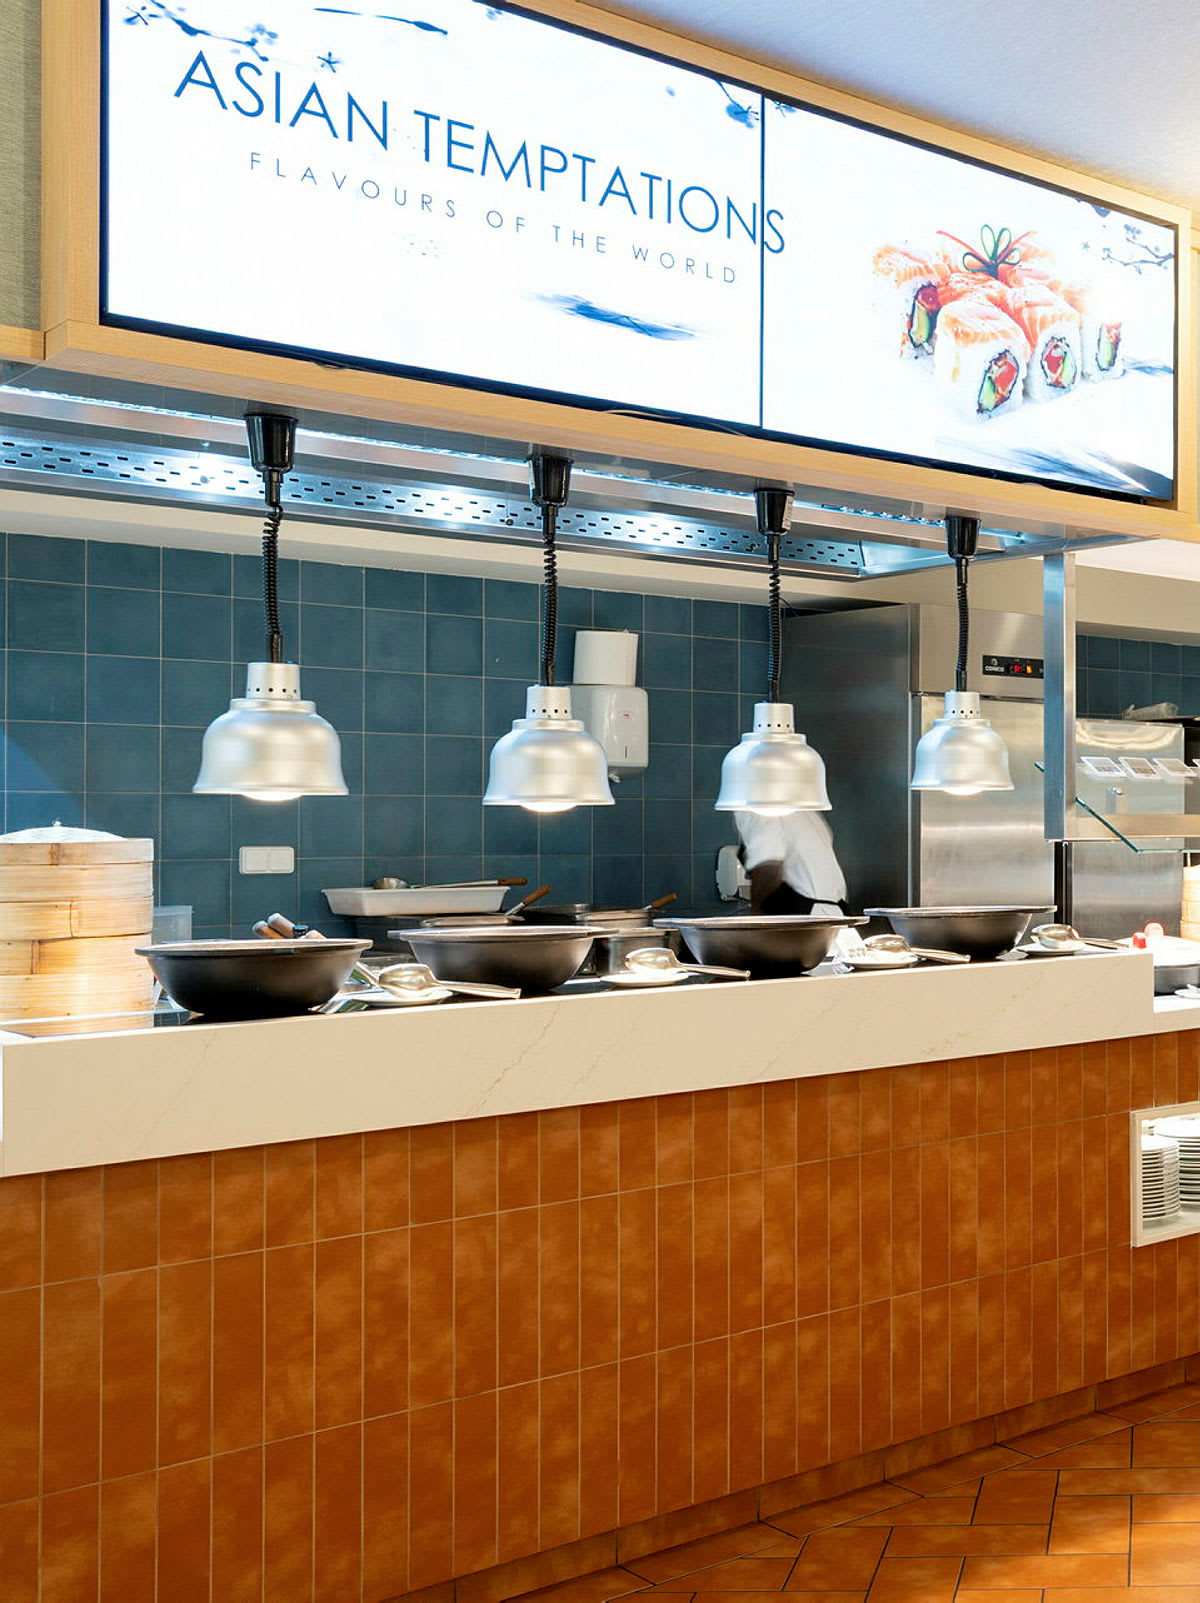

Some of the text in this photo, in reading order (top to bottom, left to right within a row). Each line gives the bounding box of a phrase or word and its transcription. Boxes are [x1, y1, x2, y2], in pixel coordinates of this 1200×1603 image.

[173, 50, 785, 255] ASIAN TEMPTATIONS
[250, 151, 736, 284] FLAVOURS OF THE WORLD
